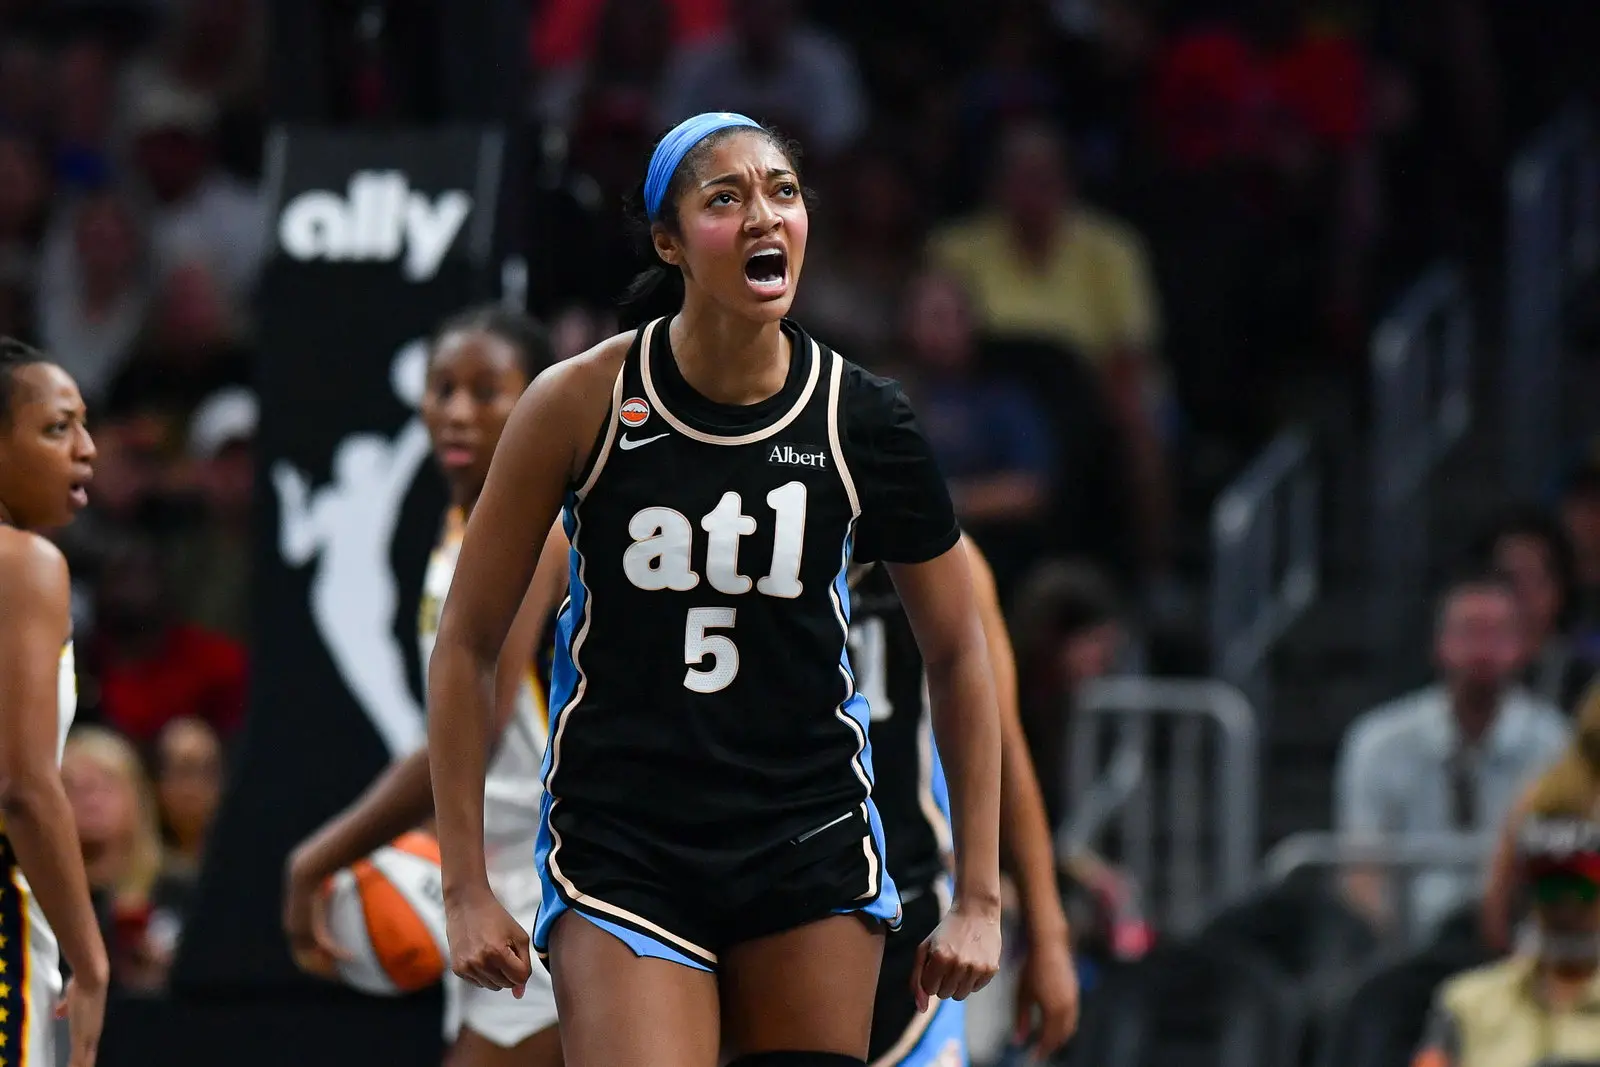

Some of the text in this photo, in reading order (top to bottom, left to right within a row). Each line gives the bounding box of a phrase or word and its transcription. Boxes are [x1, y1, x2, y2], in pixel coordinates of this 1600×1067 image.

[279, 170, 472, 281] ally
[768, 445, 826, 468] Albert
[622, 480, 807, 599] atl
[683, 606, 740, 694] 5
